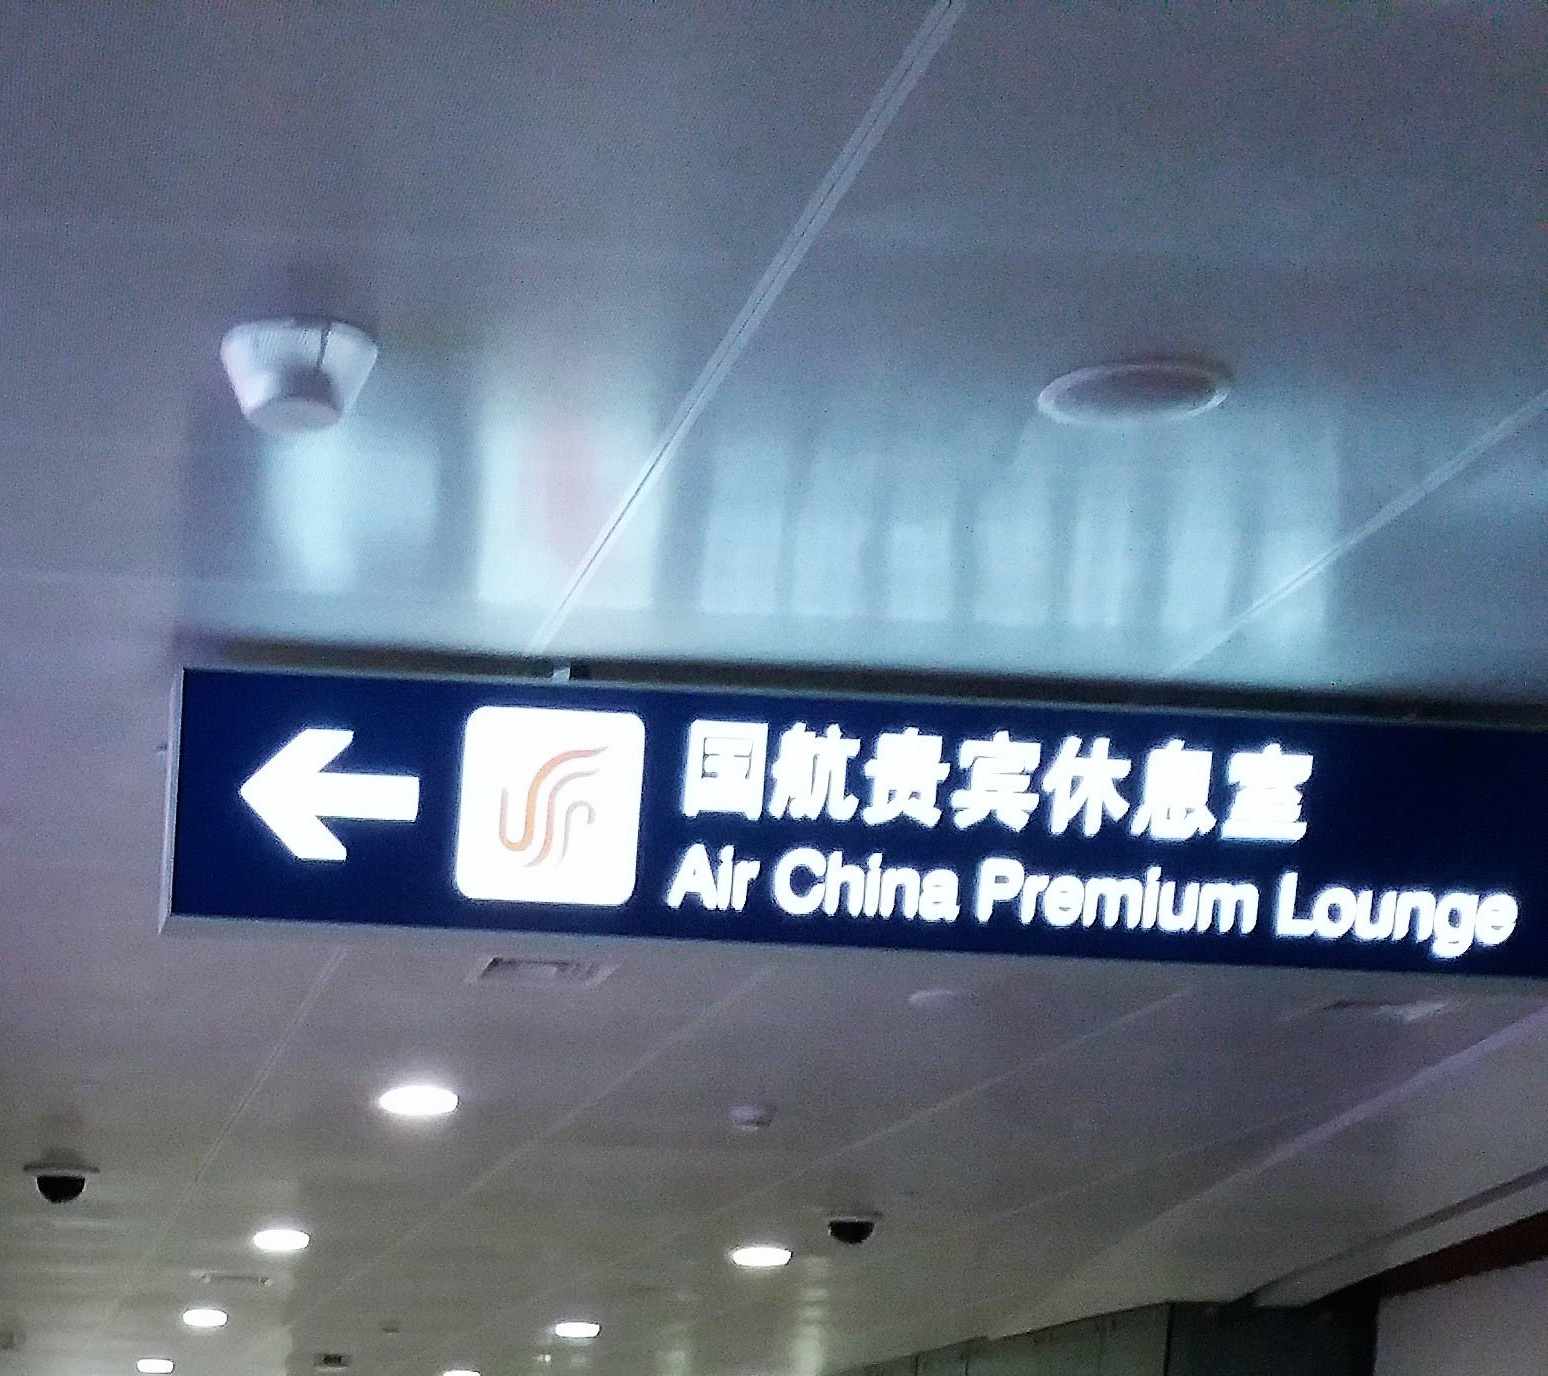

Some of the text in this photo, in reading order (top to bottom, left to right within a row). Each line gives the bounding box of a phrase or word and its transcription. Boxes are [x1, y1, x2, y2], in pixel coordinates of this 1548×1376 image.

[684, 718, 1314, 842] 国航贵宾休息室
[665, 842, 1519, 959] Air China Premium Lounge
